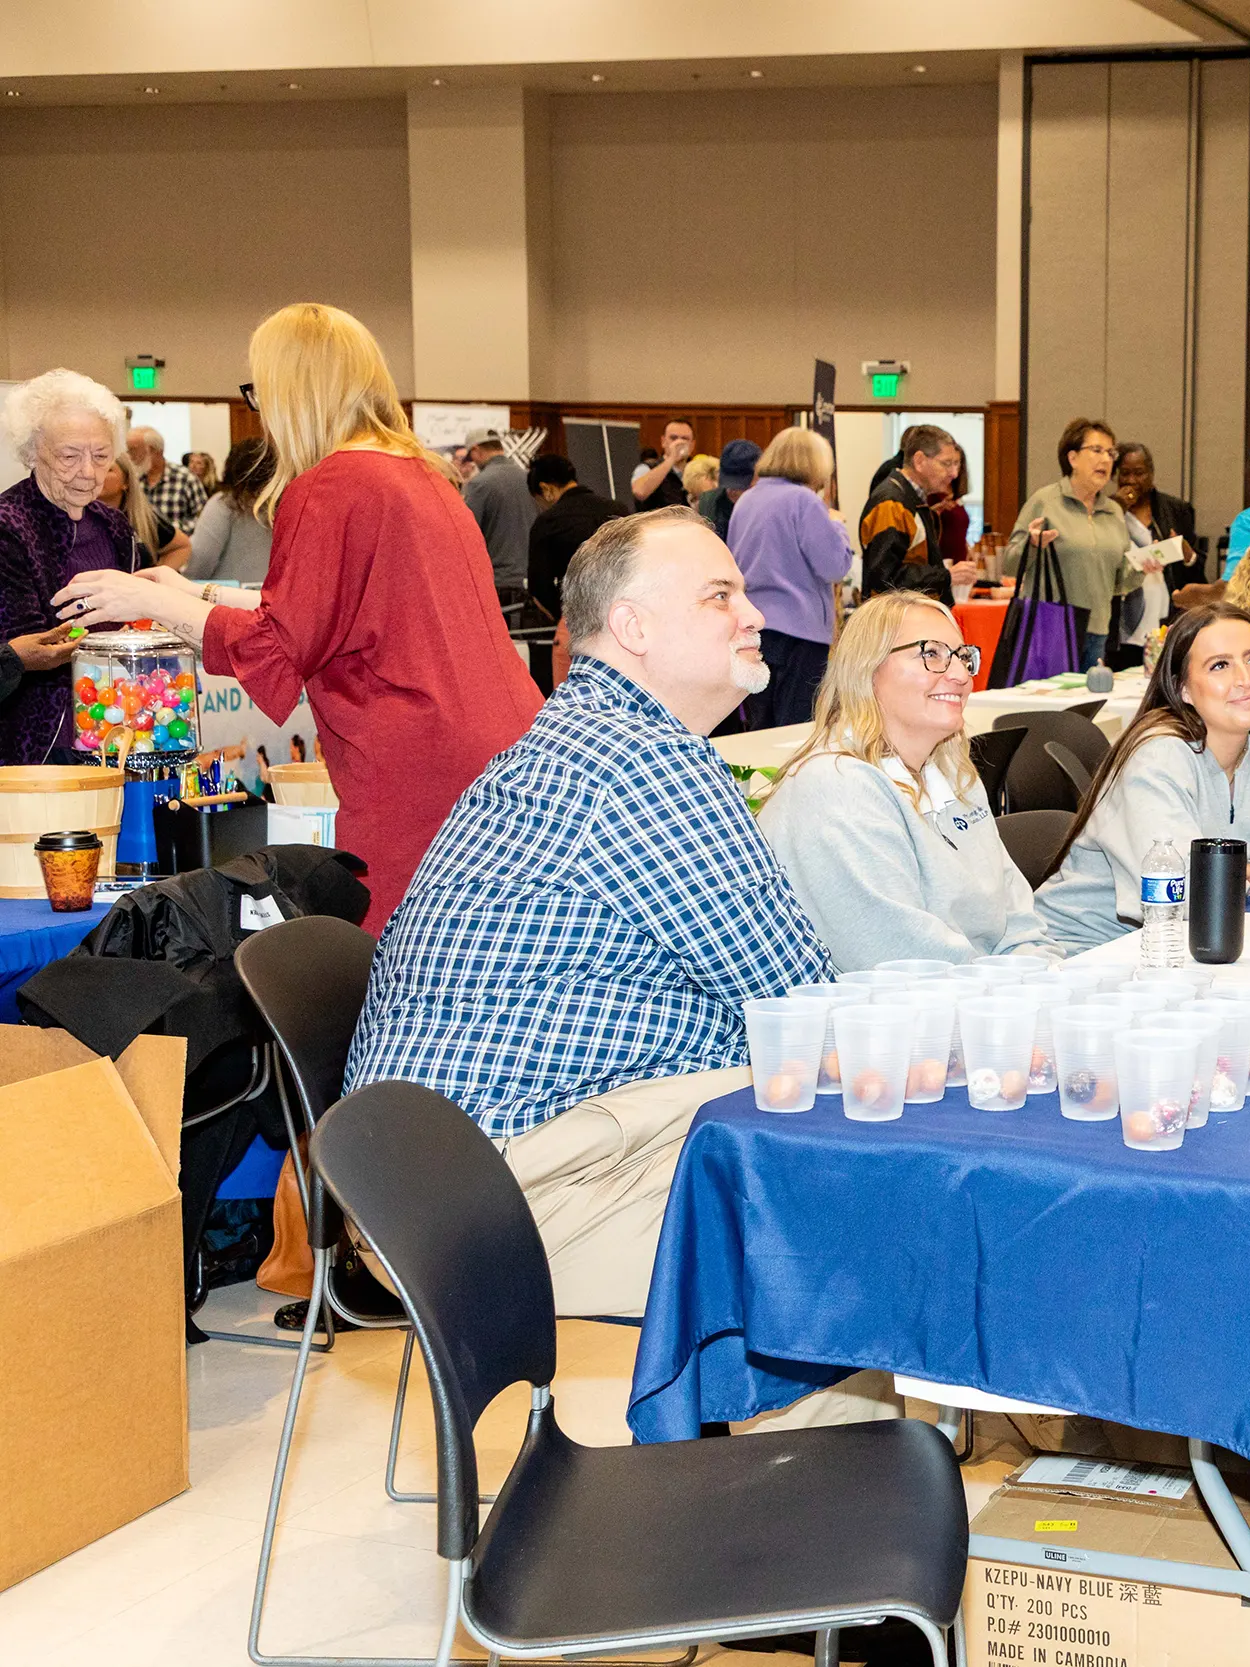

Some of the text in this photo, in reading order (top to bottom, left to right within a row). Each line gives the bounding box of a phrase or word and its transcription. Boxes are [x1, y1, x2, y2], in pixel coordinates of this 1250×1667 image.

[203, 687, 242, 713] AND
[1045, 1551, 1067, 1562] ULINE
[985, 1567, 1163, 1606] KZEPU-NAVY BLUE 深藍
[1027, 1598, 1053, 1616] 200
[1061, 1602, 1088, 1620] PCS
[987, 1616, 1110, 1647] P.O# 2301000010
[987, 1641, 1024, 1660] MADE
[1033, 1647, 1047, 1663] IN
